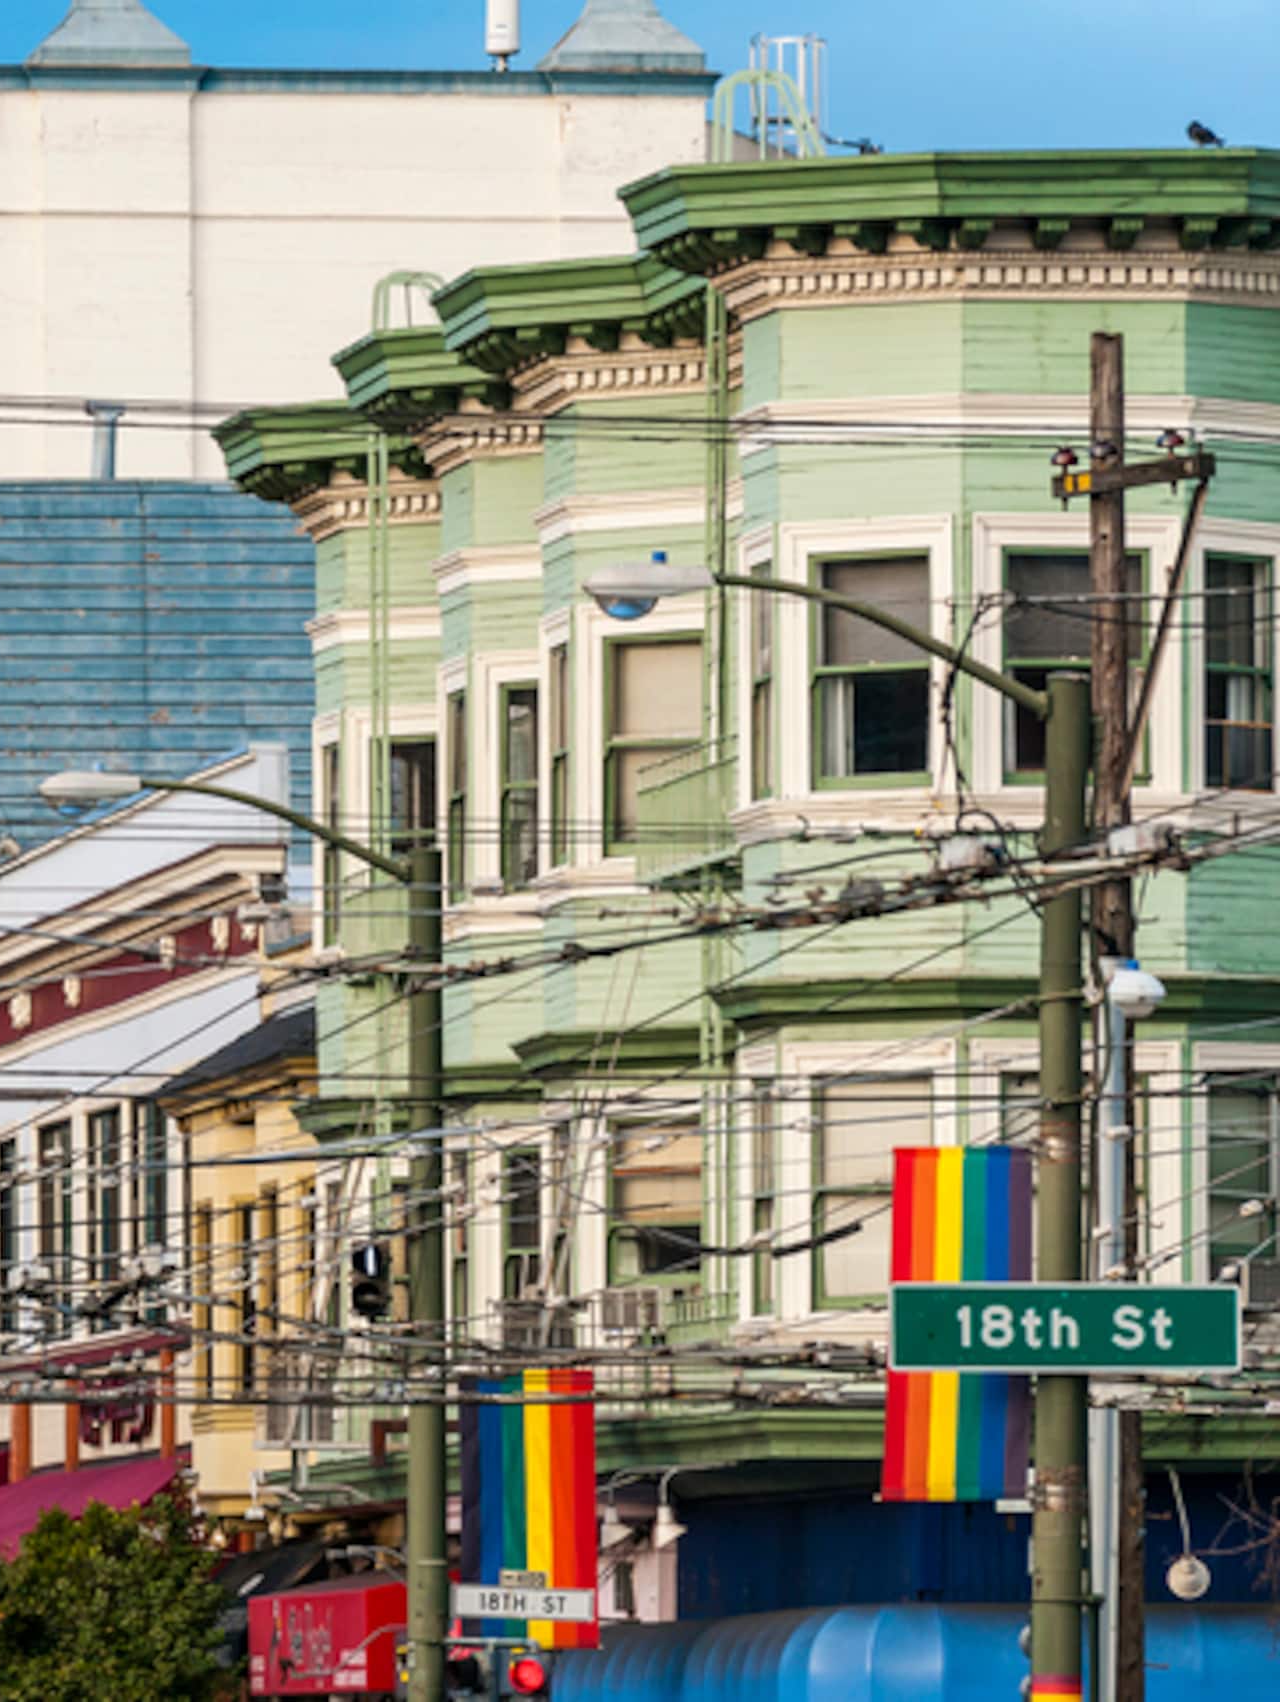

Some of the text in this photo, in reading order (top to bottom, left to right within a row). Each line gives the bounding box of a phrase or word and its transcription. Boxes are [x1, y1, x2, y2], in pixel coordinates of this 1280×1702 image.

[956, 1304, 1174, 1350] 18th St
[480, 1592, 568, 1614] 18TH ST
